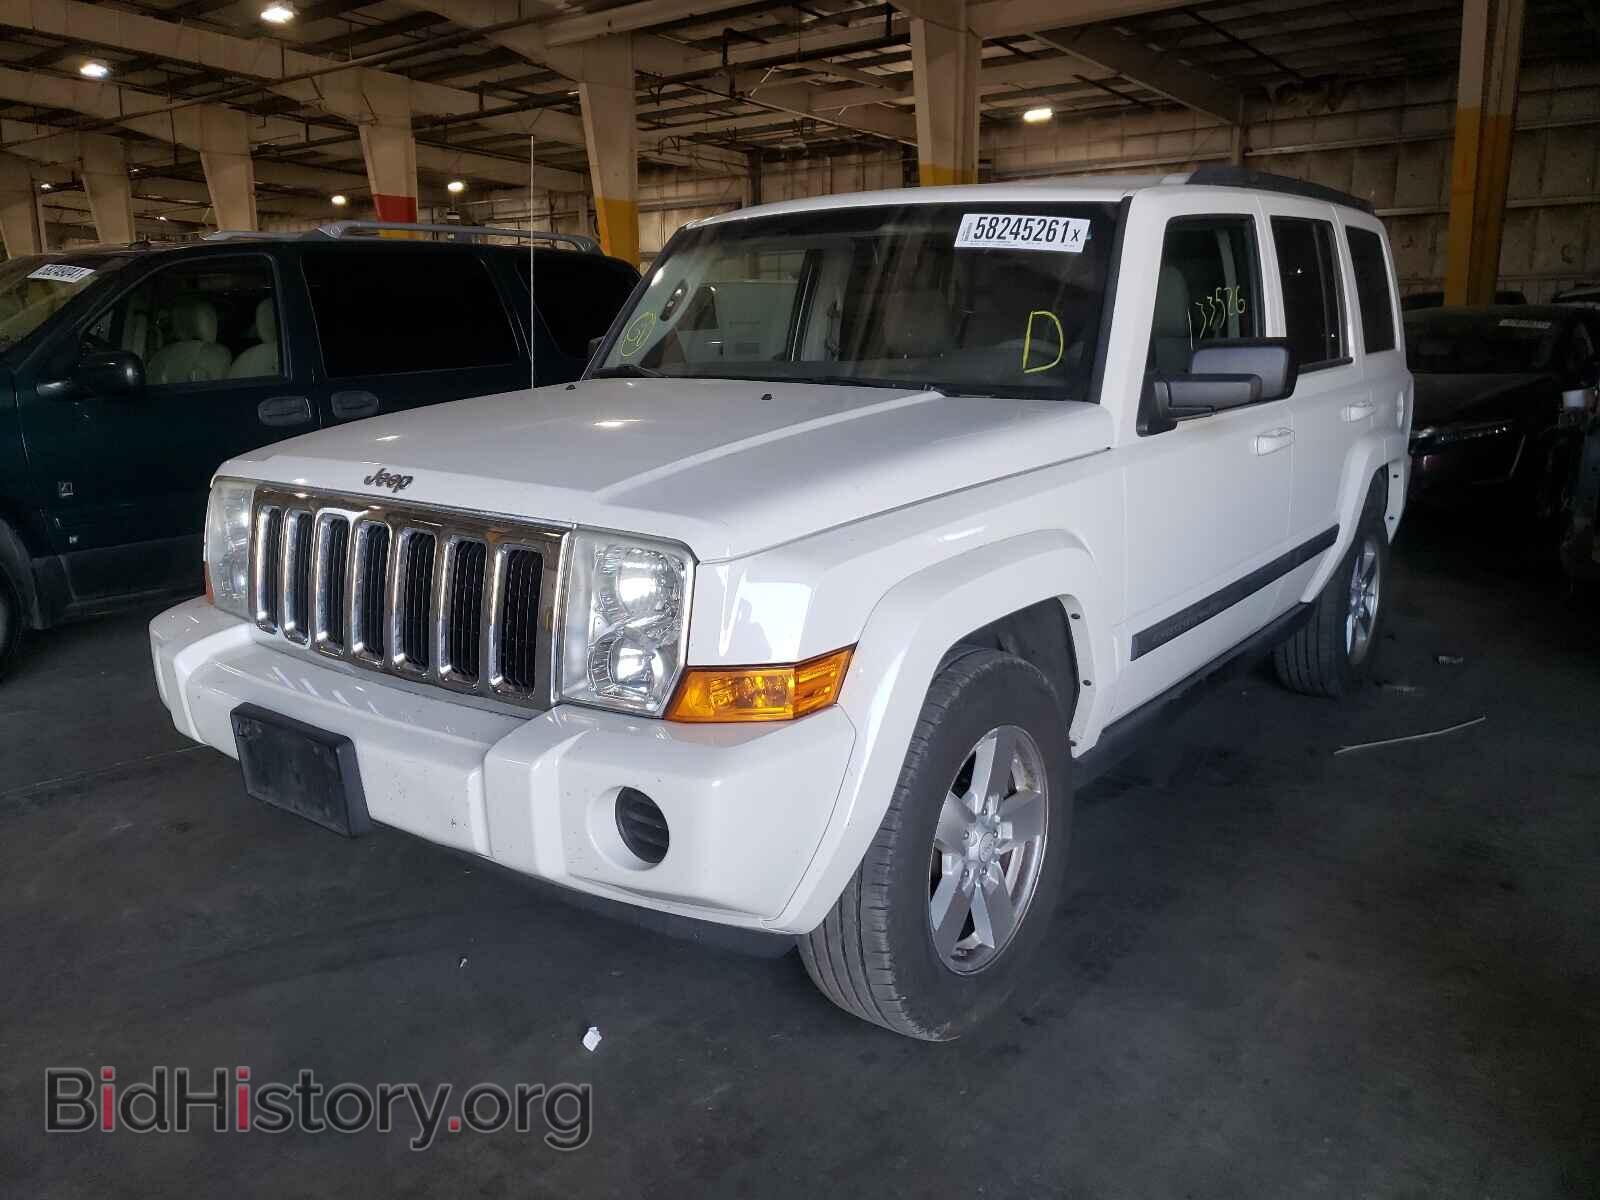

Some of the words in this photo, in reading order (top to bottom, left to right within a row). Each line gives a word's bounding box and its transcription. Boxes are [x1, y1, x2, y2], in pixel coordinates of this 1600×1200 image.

[973, 216, 1070, 243] 58245261
[1023, 310, 1064, 374] D
[363, 467, 414, 493] Jeep
